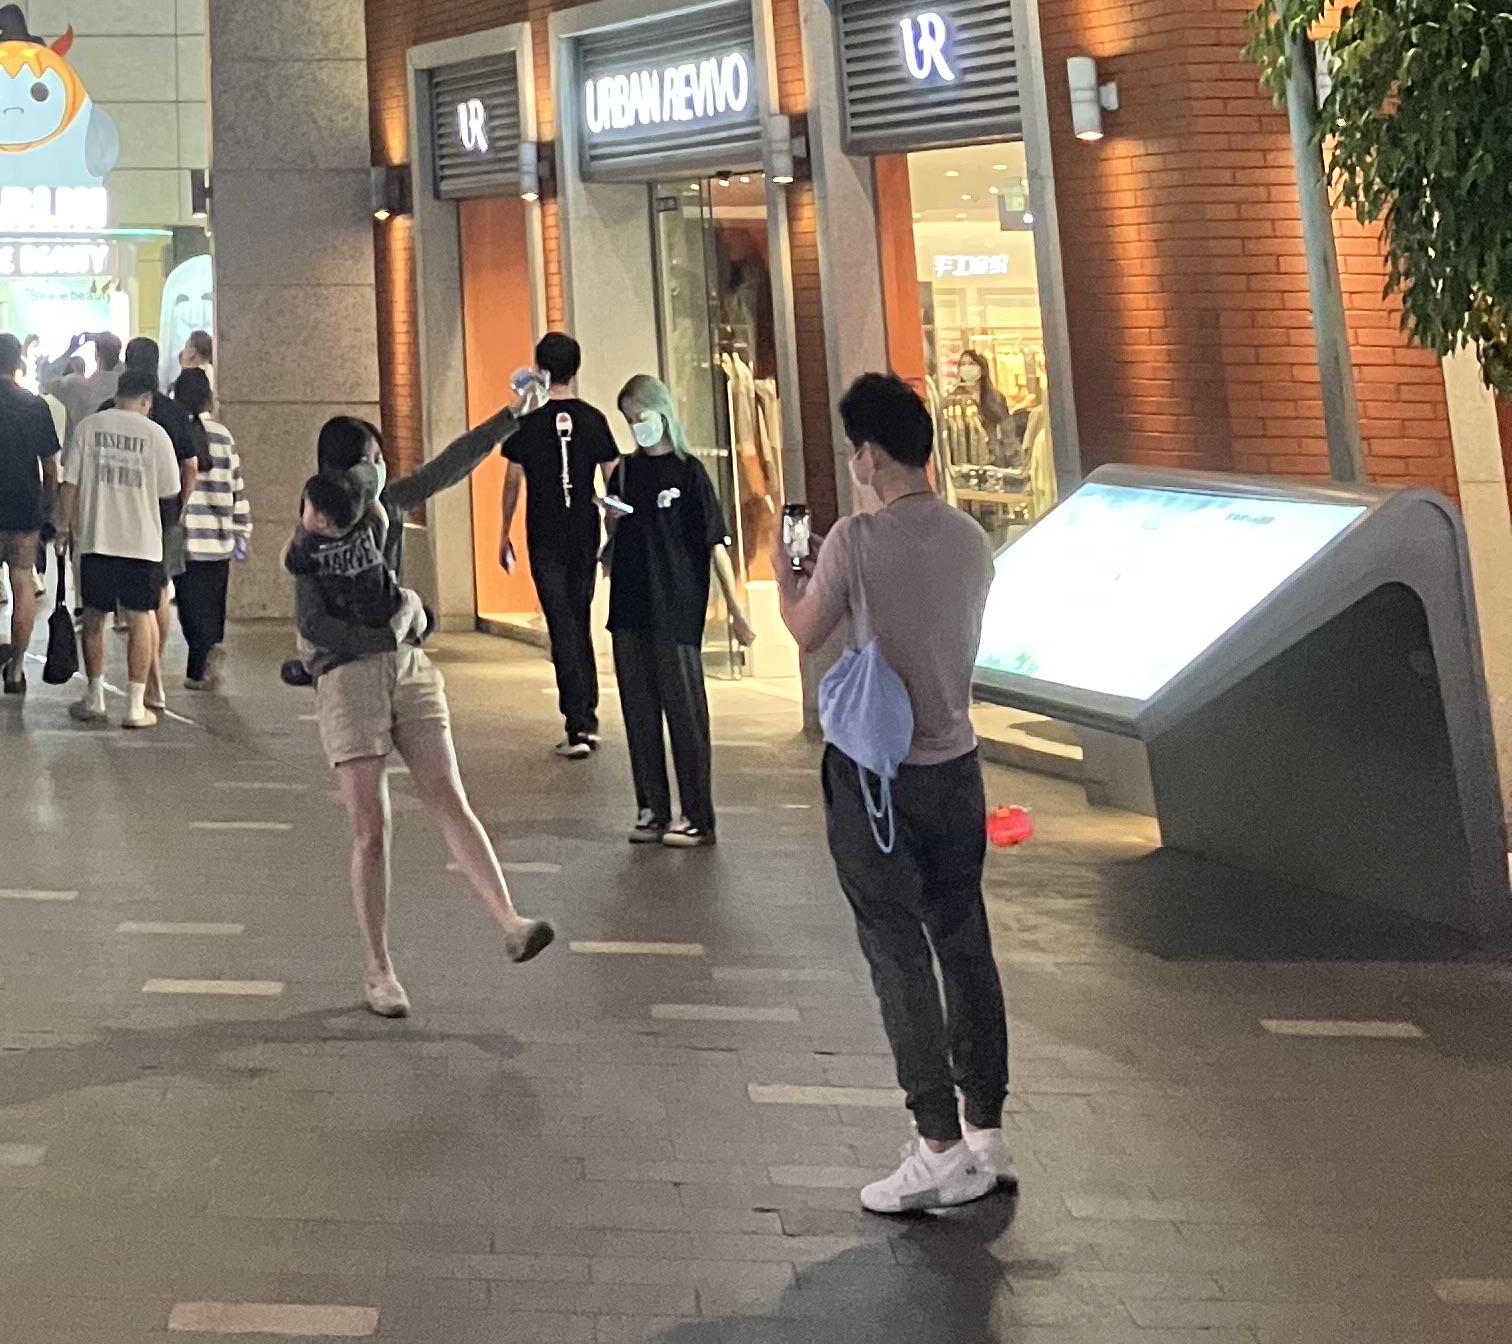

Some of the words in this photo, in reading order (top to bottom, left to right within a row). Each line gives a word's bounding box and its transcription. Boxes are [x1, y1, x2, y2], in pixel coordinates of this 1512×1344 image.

[899, 12, 956, 82] UR
[457, 97, 489, 154] UR
[585, 69, 661, 133] URBAN
[663, 52, 749, 124] REVIVO
